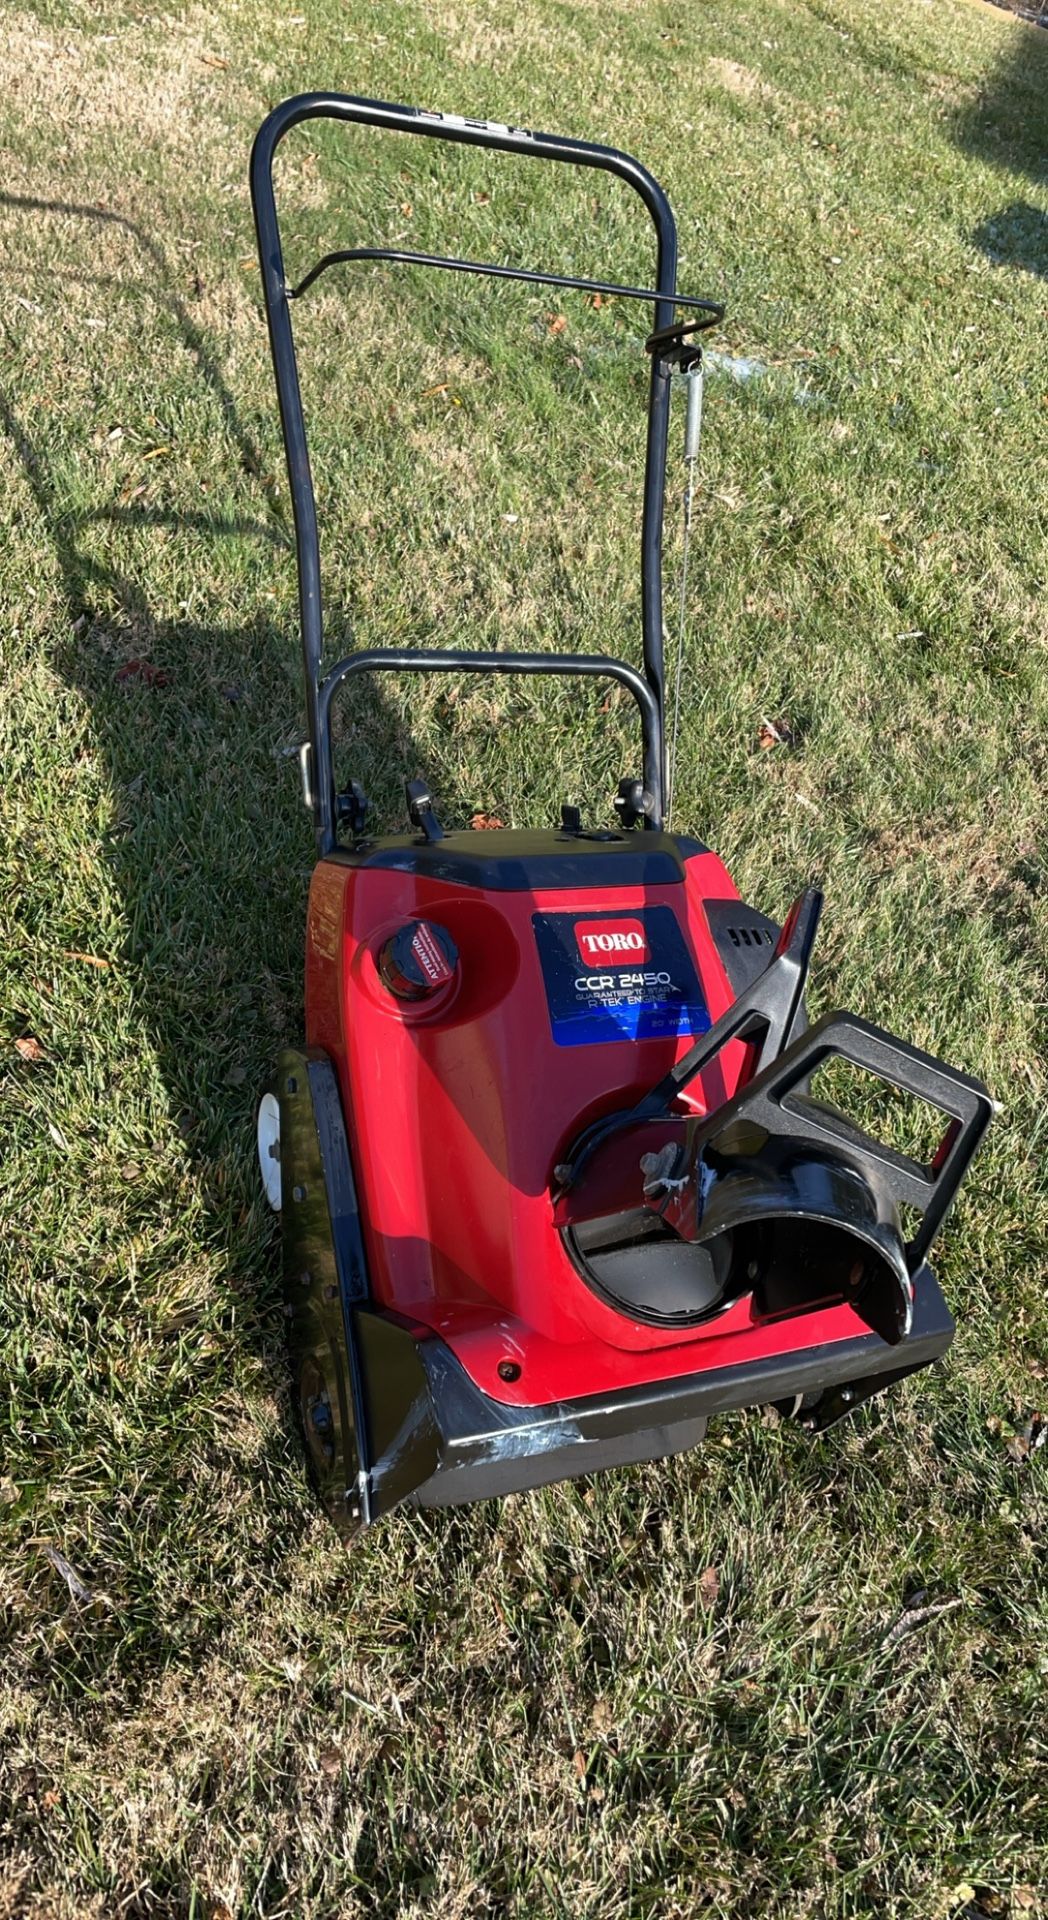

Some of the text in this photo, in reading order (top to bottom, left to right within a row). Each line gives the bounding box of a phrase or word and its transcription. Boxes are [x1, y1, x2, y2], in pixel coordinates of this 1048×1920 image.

[582, 932, 644, 953] TORO
[574, 972, 671, 991] CCR 2450
[575, 989, 632, 1001] GUARANTEED
[627, 993, 668, 1005] ENGINE
